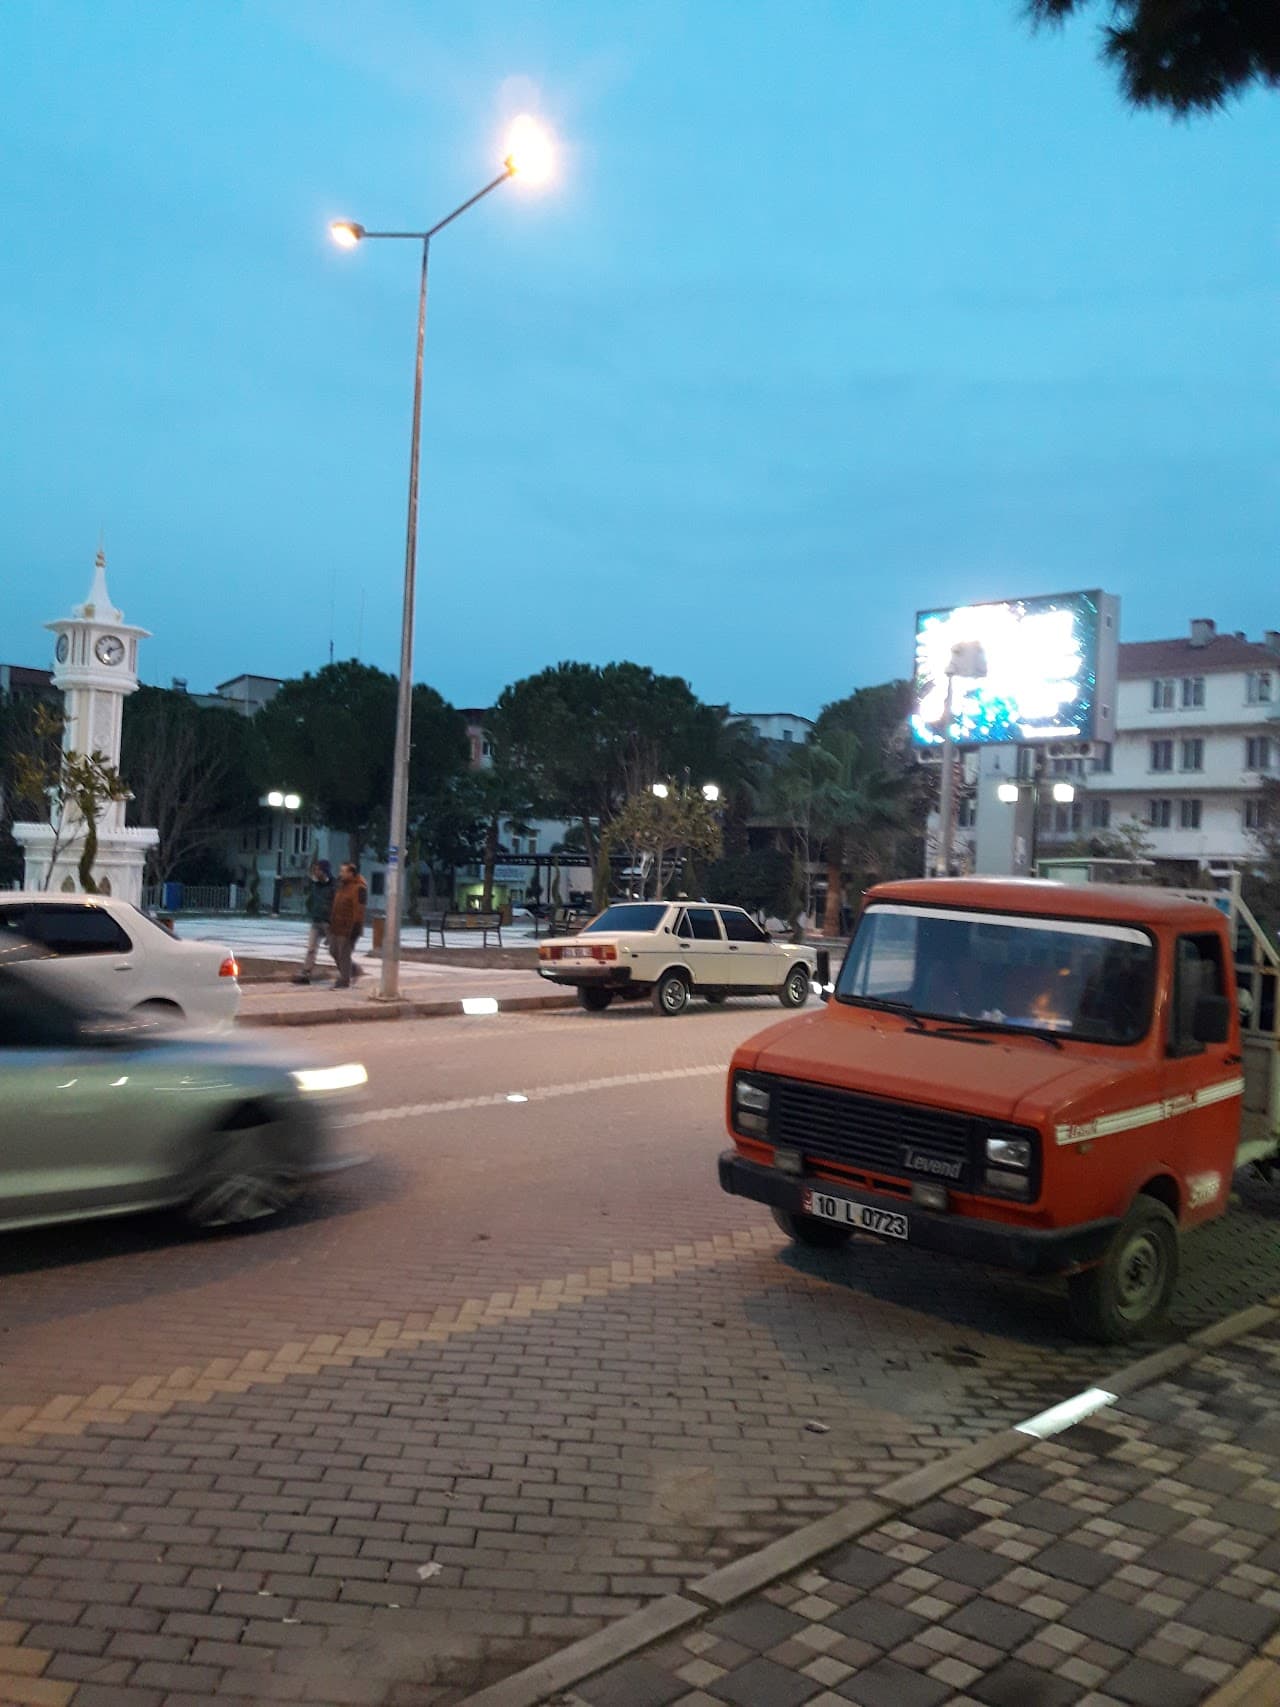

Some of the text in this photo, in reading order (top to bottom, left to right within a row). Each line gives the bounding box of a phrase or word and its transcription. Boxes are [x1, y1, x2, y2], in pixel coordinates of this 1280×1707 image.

[903, 1147, 962, 1179] Levend
[818, 1196, 835, 1217] 10
[846, 1203, 855, 1223] L
[862, 1208, 905, 1235] 0723
